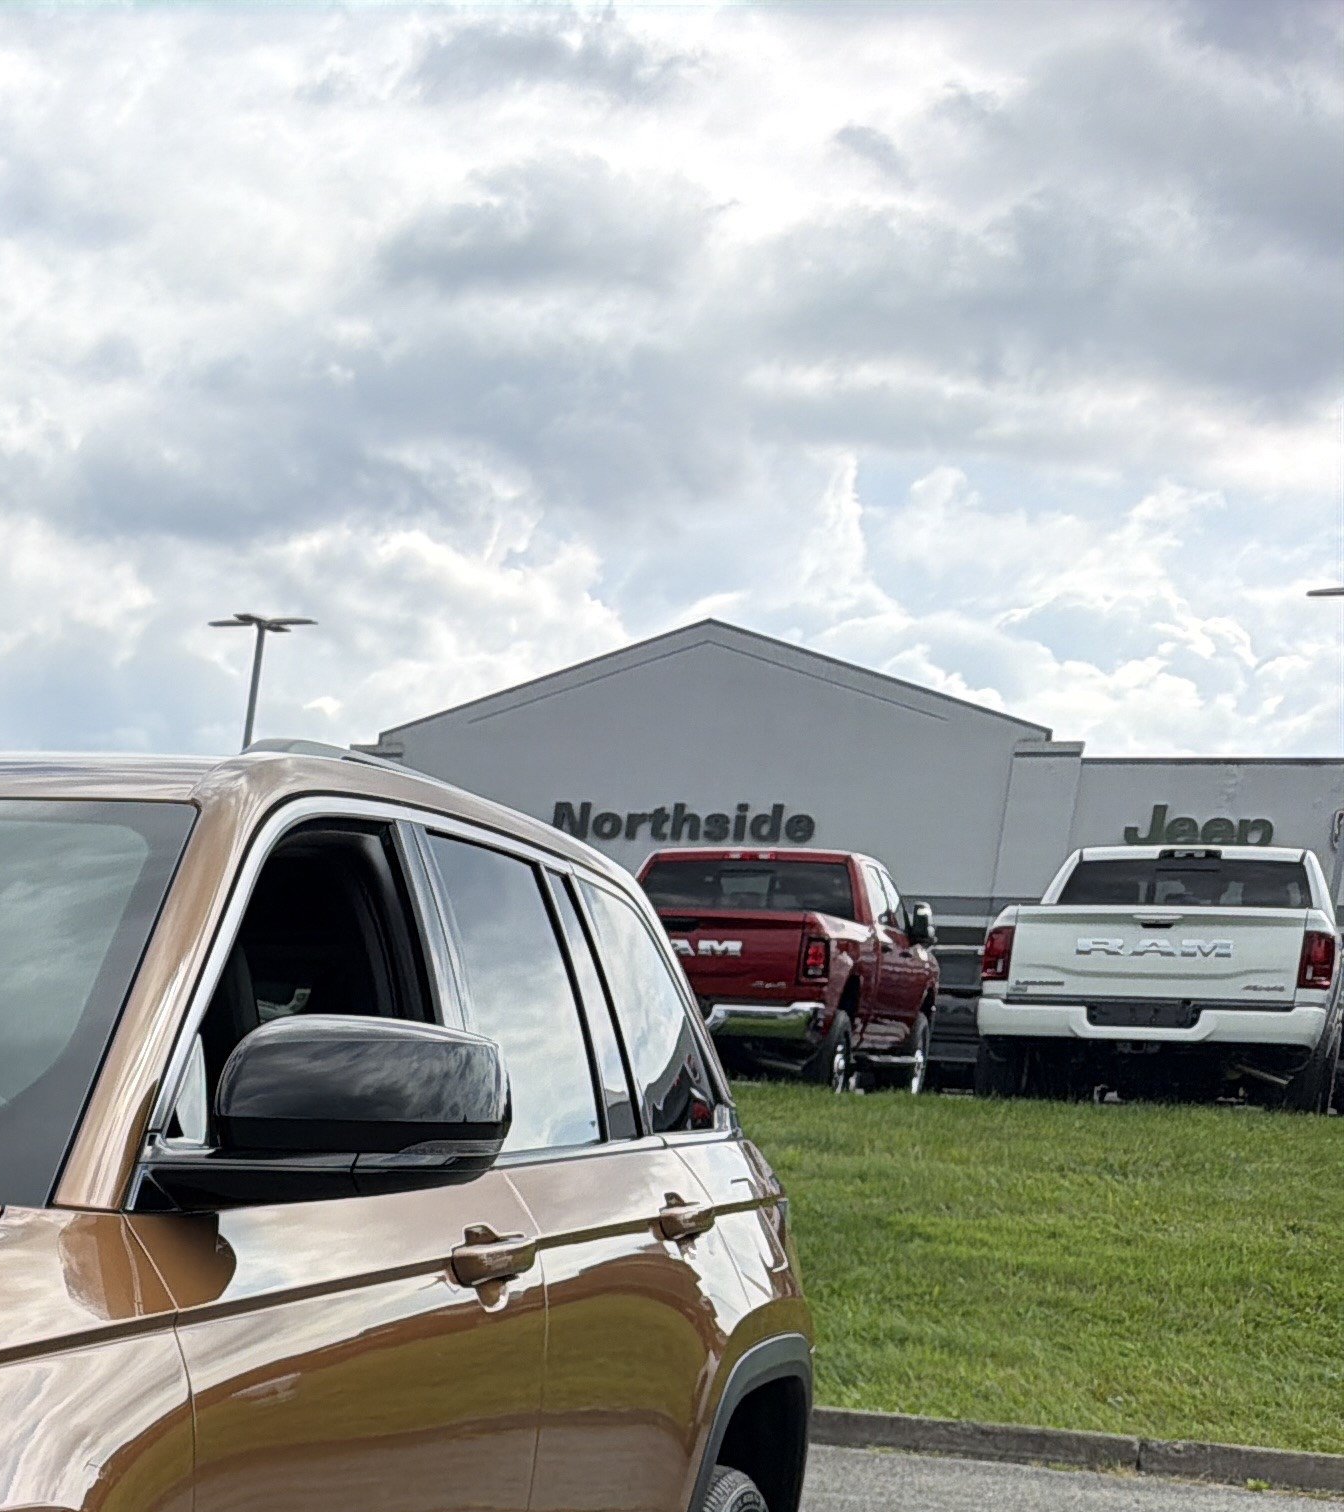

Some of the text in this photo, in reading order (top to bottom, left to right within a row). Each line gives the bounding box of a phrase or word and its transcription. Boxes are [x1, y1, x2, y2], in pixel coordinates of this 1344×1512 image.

[551, 801, 816, 843] Northside
[1123, 804, 1274, 845] Jeep
[670, 938, 743, 957] AM
[1075, 937, 1234, 958] RAM
